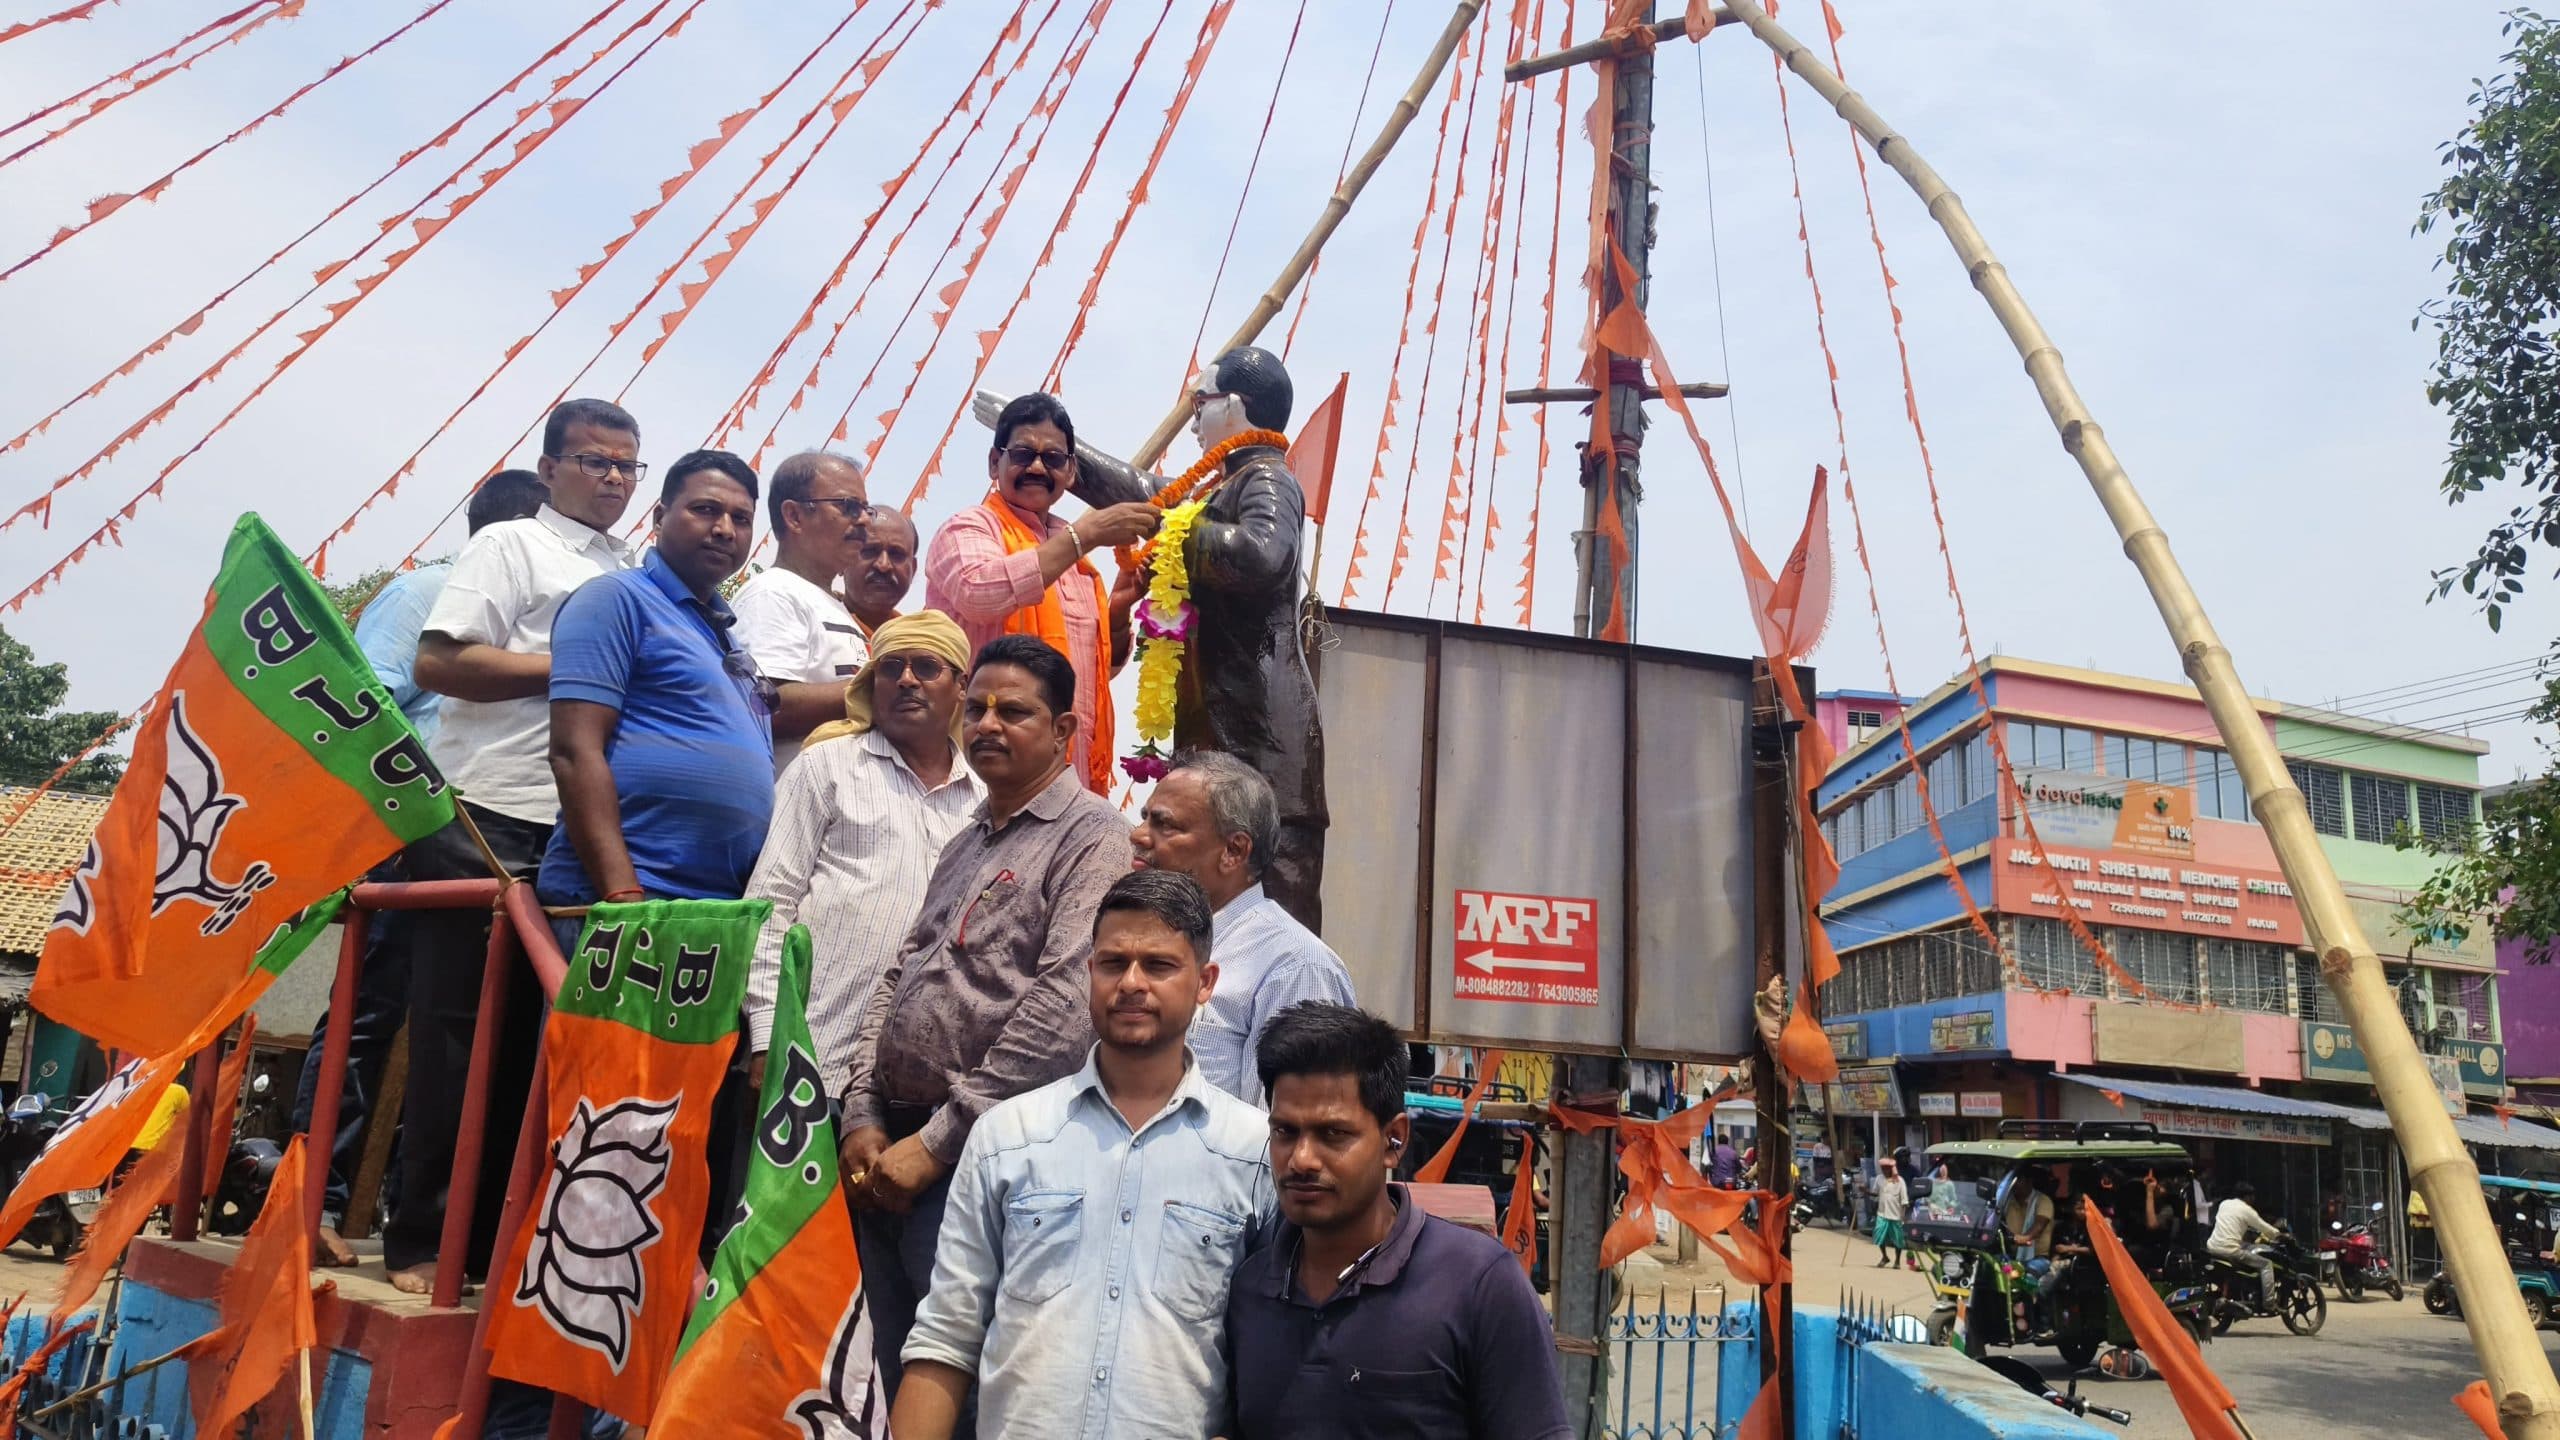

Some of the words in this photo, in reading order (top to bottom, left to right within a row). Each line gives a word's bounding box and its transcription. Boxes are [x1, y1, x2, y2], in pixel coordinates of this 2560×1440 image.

[2168, 825, 2191, 842] 90%
[2099, 859, 2171, 882] SHREYANK
[2180, 870, 2240, 890] MEDICINE
[2246, 878, 2293, 897] CENTR
[2073, 879, 2135, 896] WHOLESALE
[2140, 887, 2185, 902] MEDICINE
[2192, 893, 2239, 908] SUPPLIER
[1457, 892, 1590, 946] MRF
[2247, 917, 2278, 930] PAKUR
[2454, 1045, 2478, 1063] HALL
